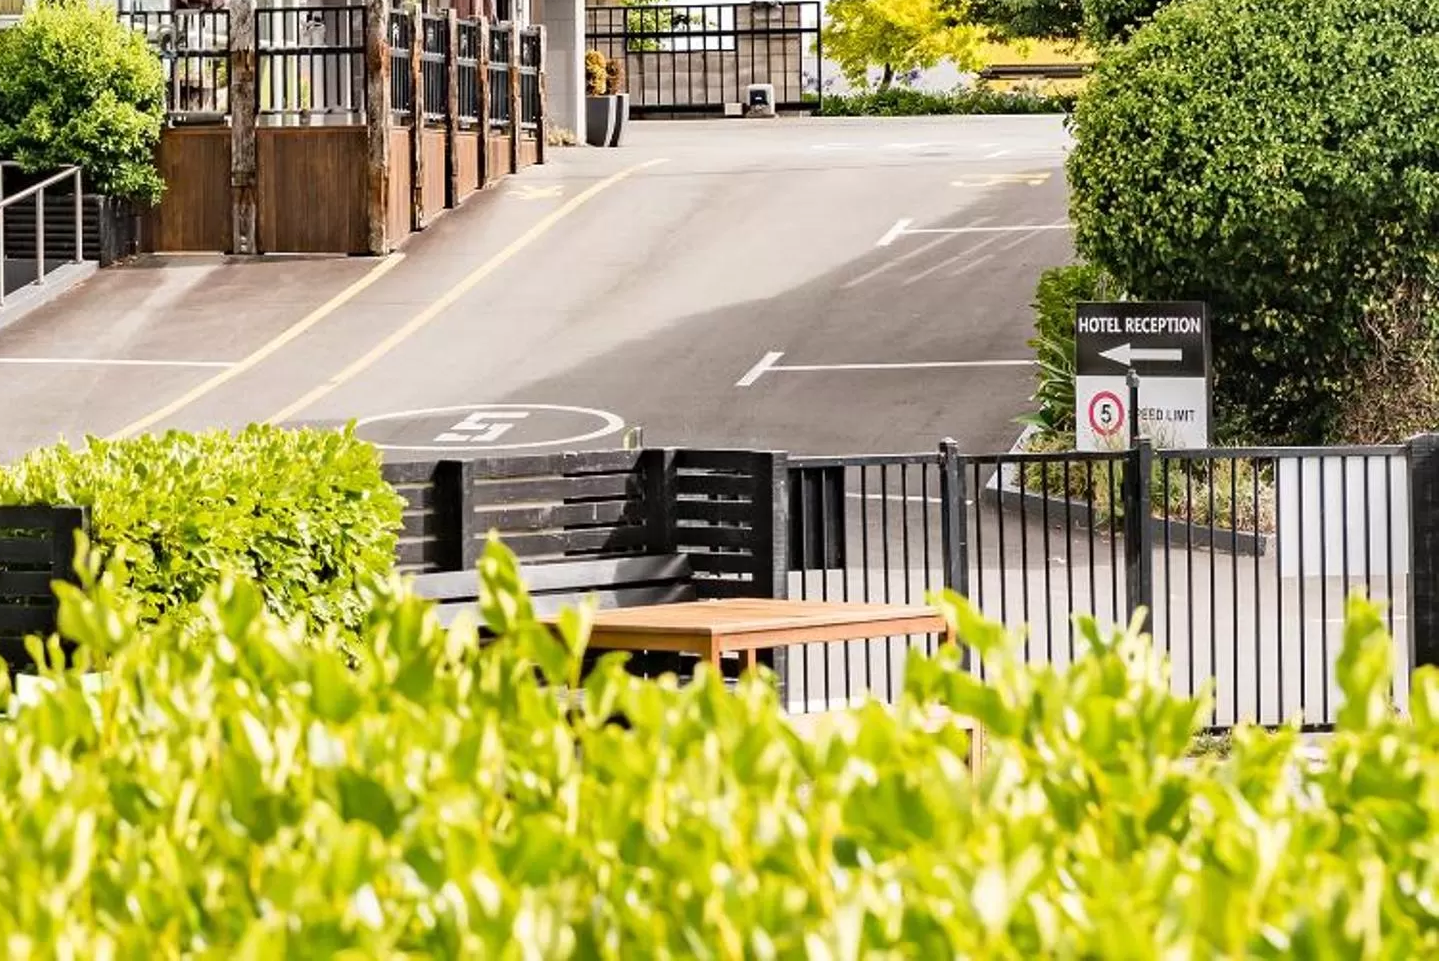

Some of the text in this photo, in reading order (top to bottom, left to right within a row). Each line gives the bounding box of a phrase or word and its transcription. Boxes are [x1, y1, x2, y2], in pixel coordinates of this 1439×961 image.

[1078, 317, 1202, 333] HOTEL RECEPTION
[1100, 404, 1112, 424] 5
[1128, 408, 1195, 422] PEED LIMIT
[433, 411, 529, 442] 5
